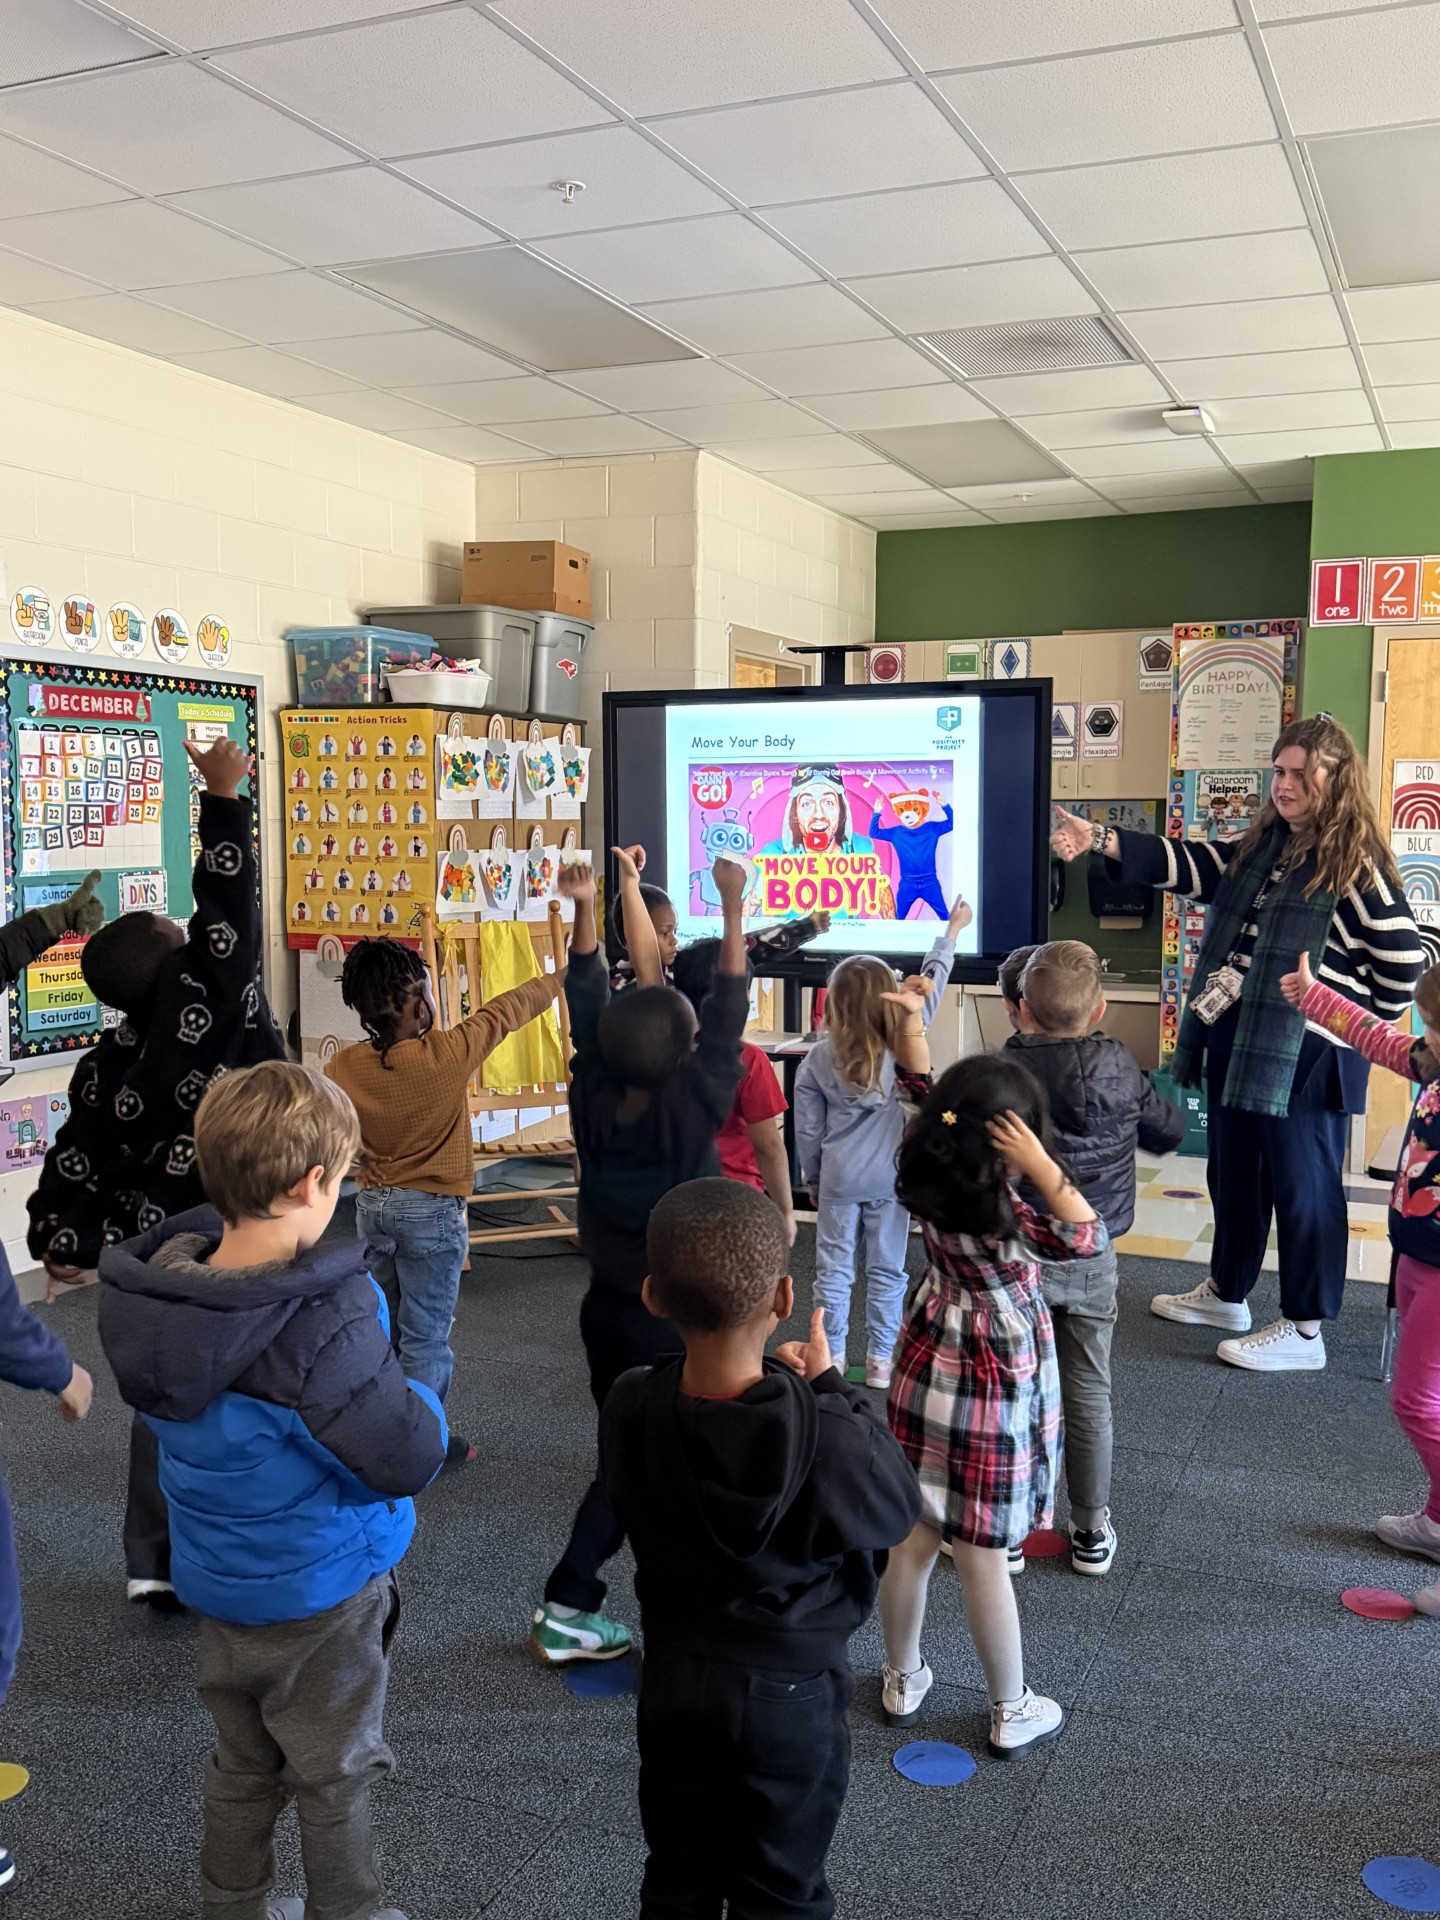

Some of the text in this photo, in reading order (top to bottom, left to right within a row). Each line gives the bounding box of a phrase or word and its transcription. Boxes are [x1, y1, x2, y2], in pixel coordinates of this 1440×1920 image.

[1334, 568, 1342, 603] 1
[1381, 566, 1406, 602] 2
[1325, 606, 1350, 617] one
[1379, 602, 1408, 616] two
[1208, 670, 1253, 682] HAPPY
[1192, 682, 1270, 694] BIRTHDAY!
[48, 693, 134, 716] DECEMBER
[206, 708, 232, 718] Schedule
[346, 716, 377, 724] Action
[379, 716, 408, 724] Tricks
[49, 740, 54, 750] 1
[70, 740, 76, 750] 2
[90, 740, 96, 750] 3
[110, 742, 116, 752] 4
[148, 742, 154, 752] 6
[692, 734, 795, 750] Move Your Body
[132, 745, 137, 754] 5
[1052, 749, 1072, 757] angle
[1084, 749, 1117, 757] Hexagon
[27, 762, 33, 772] 7
[50, 762, 56, 772] 8
[72, 762, 78, 773] 9
[89, 763, 98, 774] 10
[110, 762, 118, 773] 11
[131, 767, 140, 777] 12
[148, 766, 158, 776] 13
[1416, 766, 1434, 780] RED
[1204, 776, 1254, 784] Classroom
[26, 786, 38, 796] 14
[48, 786, 58, 796] 15
[71, 785, 80, 796] 16
[90, 786, 100, 796] 17
[109, 788, 120, 798] 18
[131, 788, 140, 797] 19
[149, 786, 158, 796] 20
[696, 784, 727, 803] GO!
[1208, 784, 1248, 798] Helpers
[28, 806, 40, 818] 21
[49, 809, 59, 820] 22
[72, 810, 82, 820] 23
[90, 810, 100, 820] 24
[130, 808, 140, 818] 26
[146, 806, 156, 816] 27
[26, 832, 36, 844] 28
[48, 833, 58, 844] 29
[72, 830, 83, 840] 30
[90, 830, 100, 840] 31
[1408, 838, 1432, 852] BLUE
[825, 857, 876, 875] YOUR
[42, 889, 73, 900] Sunda
[130, 884, 157, 904] DAYS
[1414, 908, 1434, 922] ACK
[34, 950, 80, 962] Wednesd
[40, 970, 82, 983] Thursda
[48, 991, 84, 1003] Friday
[40, 1010, 91, 1024] Saturday
[104, 1016, 115, 1024] 50
